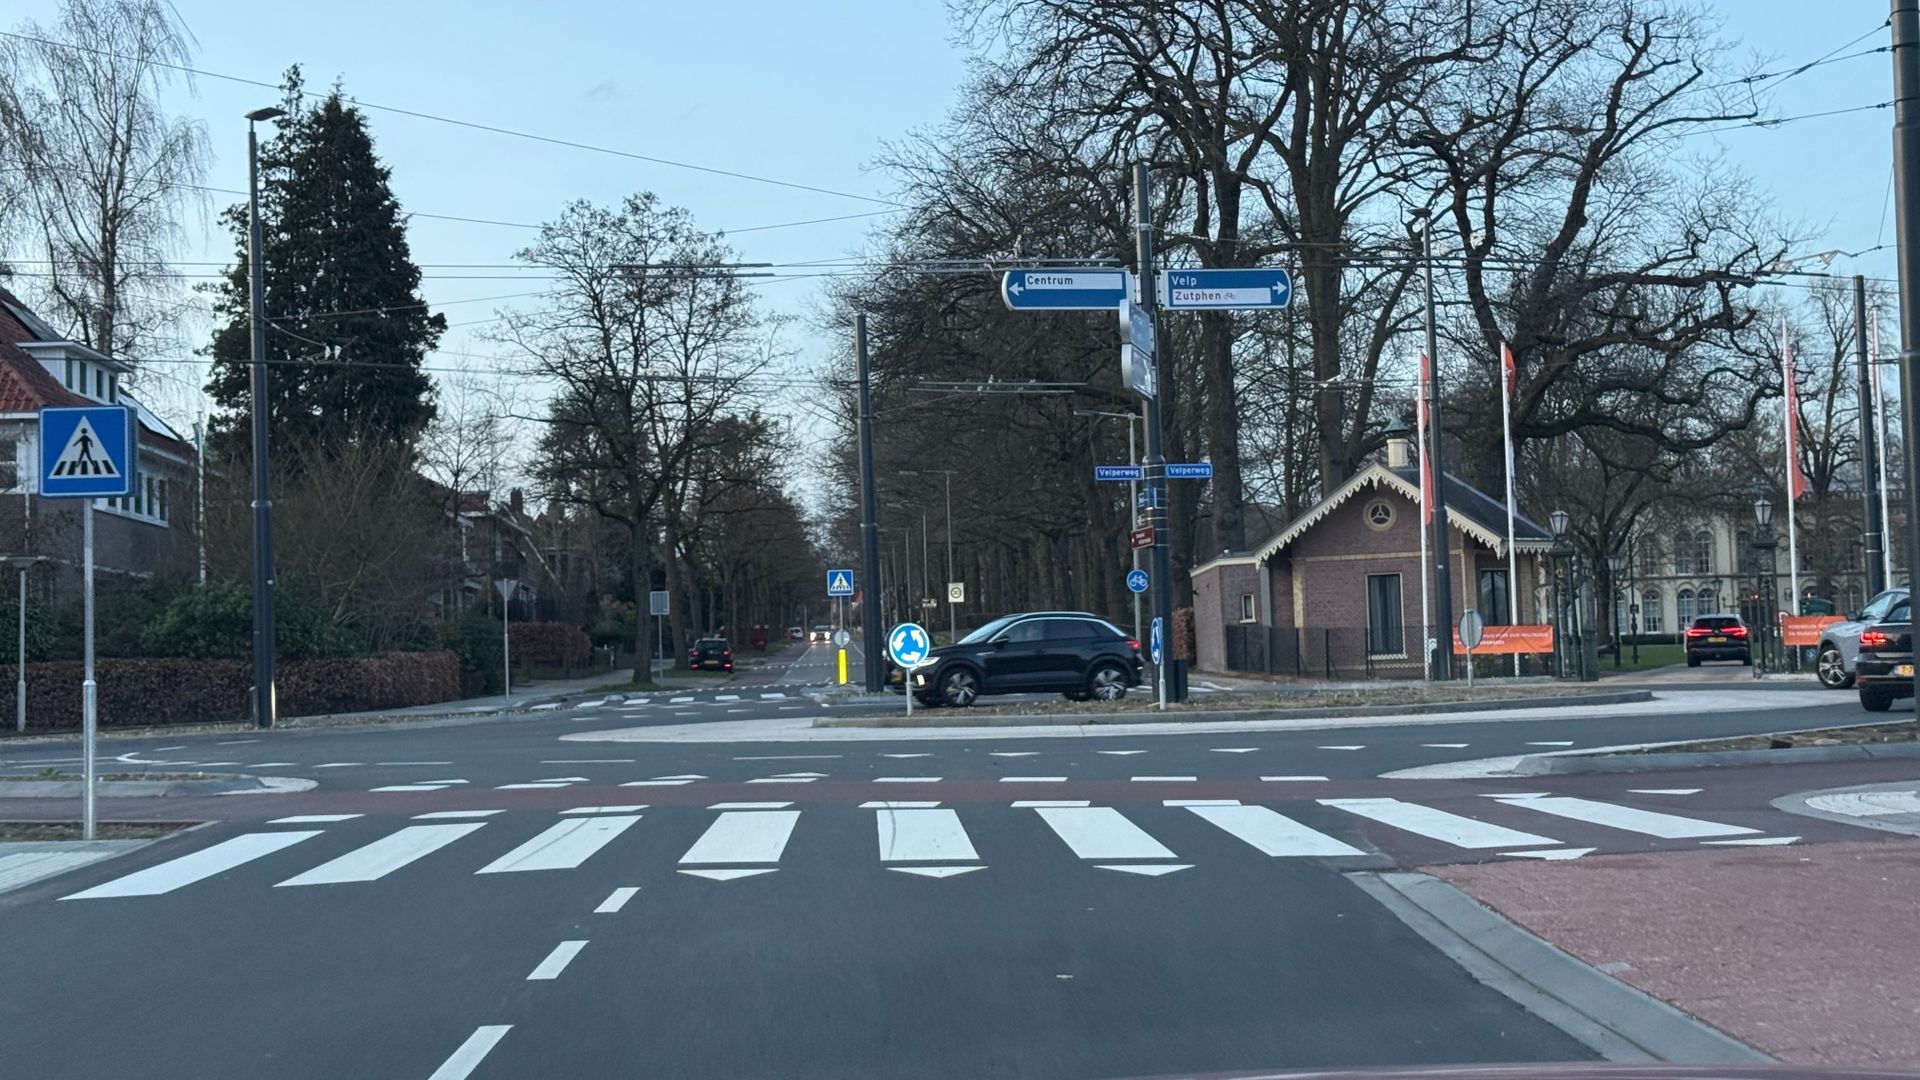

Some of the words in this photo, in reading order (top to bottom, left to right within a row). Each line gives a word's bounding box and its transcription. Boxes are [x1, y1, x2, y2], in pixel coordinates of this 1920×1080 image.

[1027, 275, 1073, 285] Centrum
[1171, 275, 1197, 287] Velp
[1175, 291, 1221, 302] Zutphen
[1099, 468, 1139, 478] Velperweg
[1170, 466, 1210, 476] Velperweg
